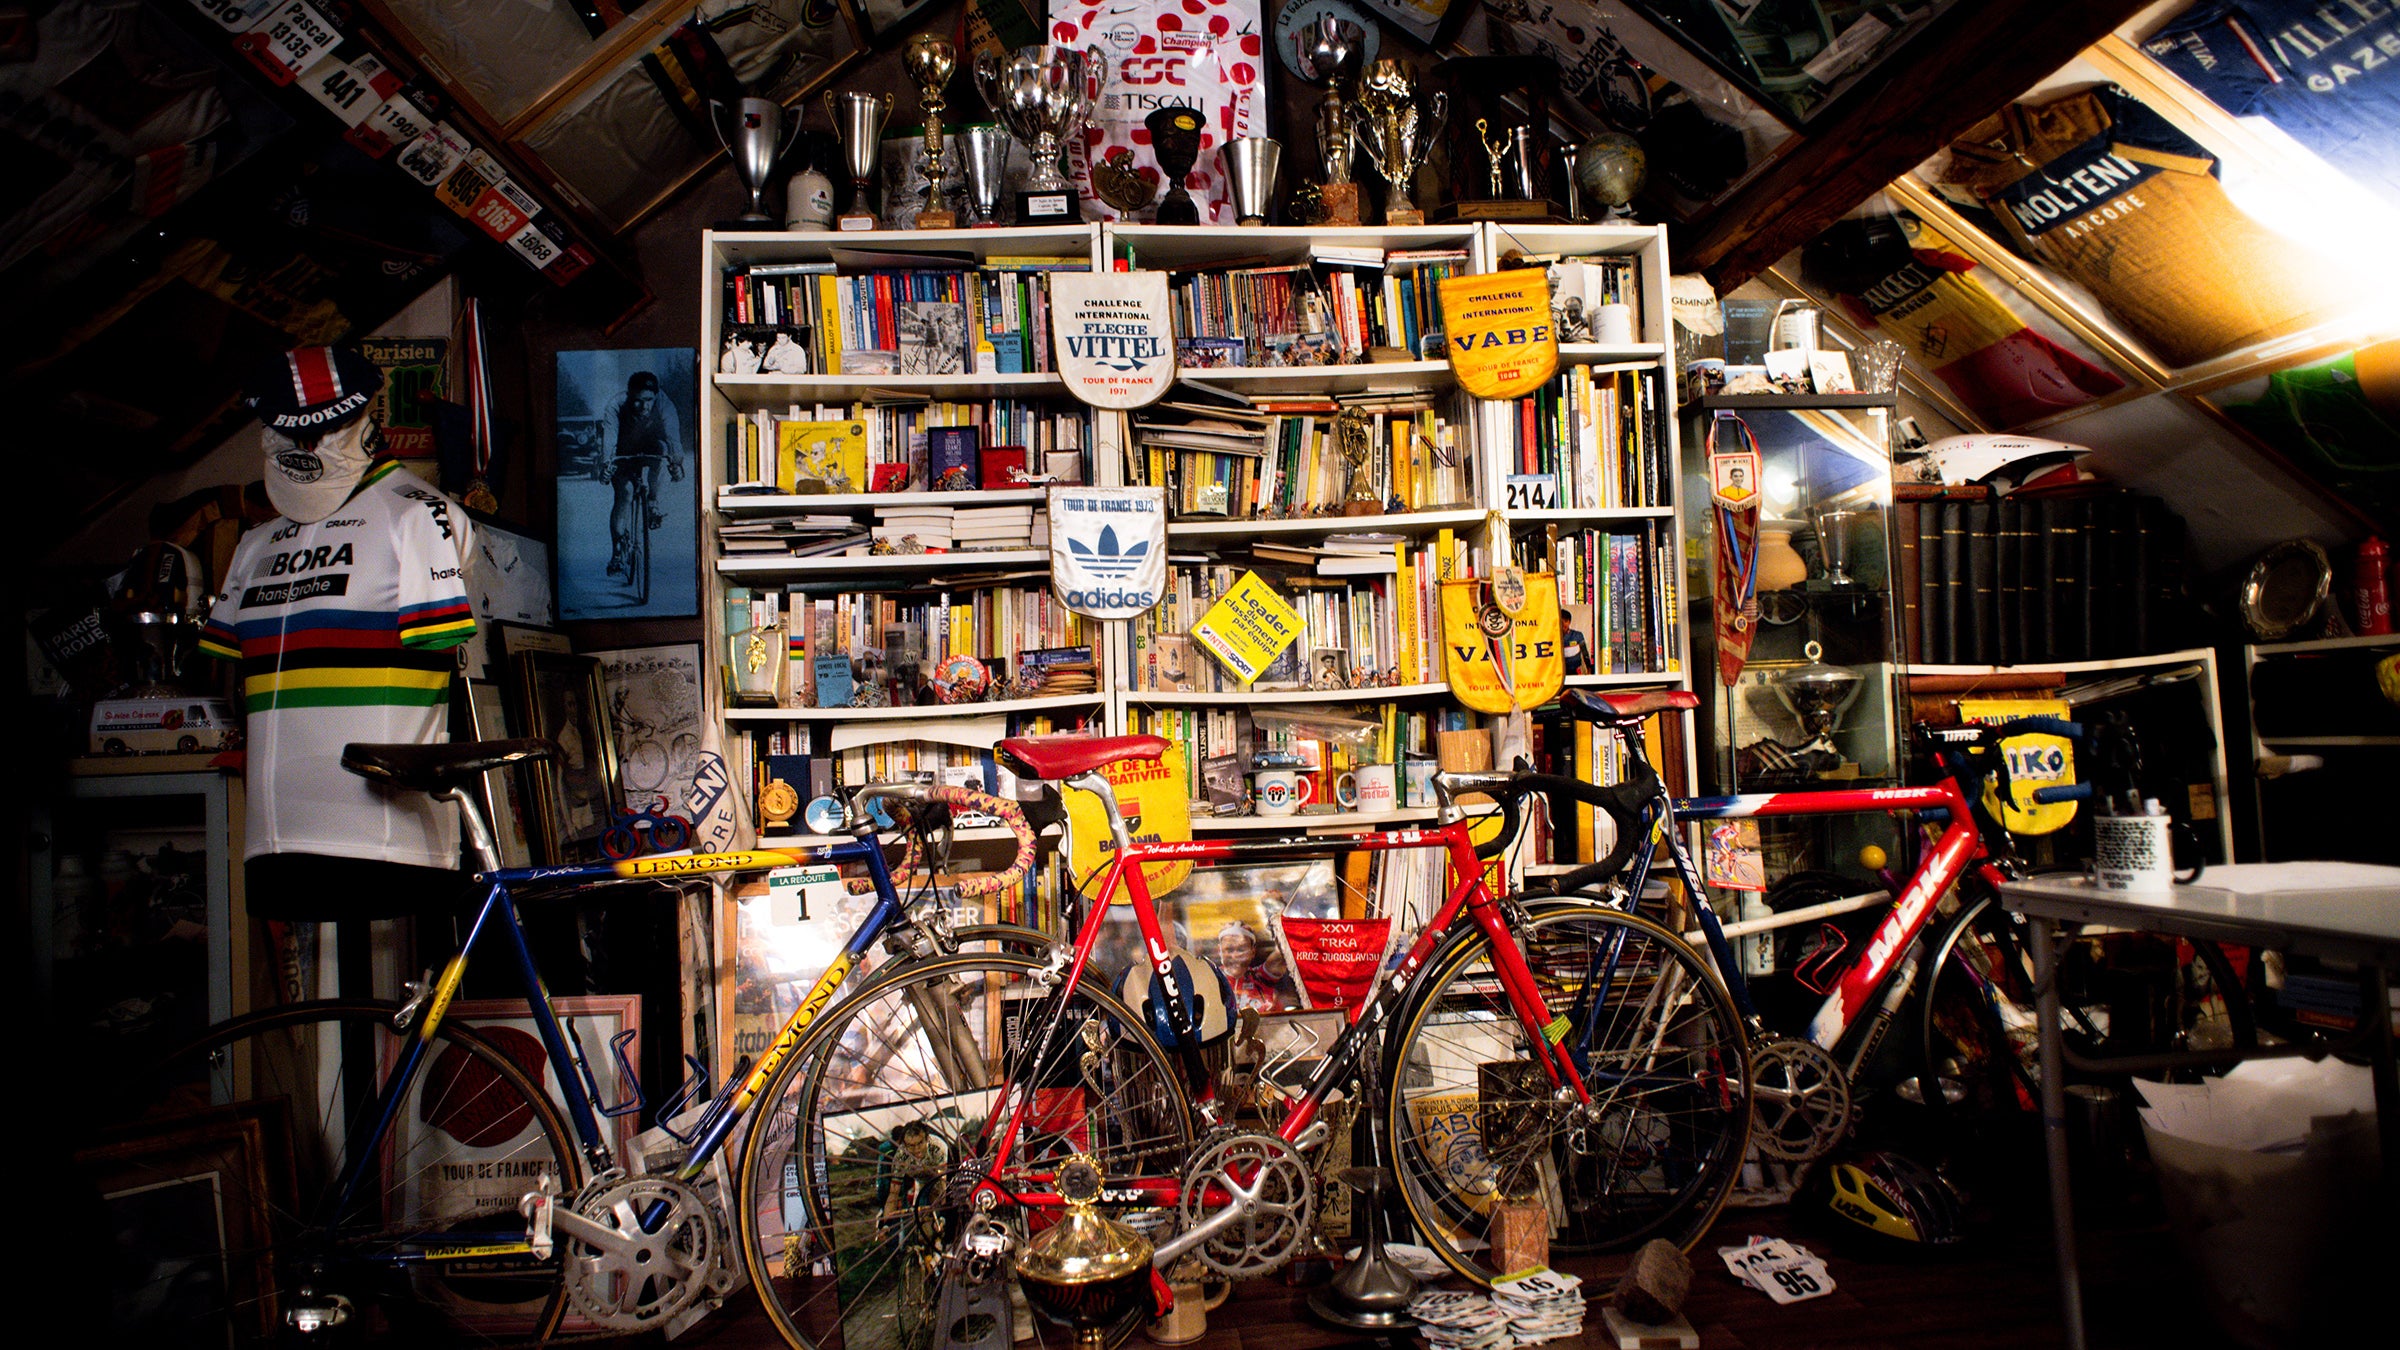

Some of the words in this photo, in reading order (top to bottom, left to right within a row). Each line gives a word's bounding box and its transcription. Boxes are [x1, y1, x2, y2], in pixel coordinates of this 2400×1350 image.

[285, 3, 334, 47] Pascal
[269, 22, 311, 59] 13135
[1163, 37, 1212, 48] Champion
[1121, 58, 1186, 86] CSC
[322, 69, 367, 110] 441
[476, 198, 518, 233] 3163
[2064, 193, 2147, 239] ARCORE
[859, 277, 868, 311] ANQUETIL
[1084, 300, 1142, 308] CHALLENGE
[1469, 291, 1524, 303] CHALLENGE
[827, 307, 836, 327] JAUNE
[1075, 312, 1151, 321] INTERNATIONAL
[1463, 306, 1534, 319] INTERNATIONAL
[1083, 323, 1148, 335] FLECHE
[1454, 326, 1549, 351] VABE
[362, 343, 436, 360] Parisien
[827, 328, 836, 355] MAILLOT
[1066, 336, 1166, 359] VITTEL
[1478, 363, 1498, 372] TOUR
[1513, 357, 1539, 367] FRANCE
[273, 392, 368, 428] BROOKLYN
[404, 489, 453, 541] BORA
[1063, 499, 1085, 511] TOUR
[1088, 499, 1098, 512] DE
[1101, 500, 1132, 512] FRANCE
[1135, 500, 1154, 512] 1973
[275, 524, 299, 542] UCI
[325, 518, 359, 528] CRAFT
[270, 543, 353, 577] BORA
[430, 567, 464, 582] hansg
[255, 579, 332, 602] hansgrohe
[1066, 587, 1153, 609] adidas
[940, 592, 950, 619] TOUR
[1240, 588, 1290, 637] Leader
[1246, 609, 1258, 621] du
[1225, 598, 1279, 649] classement
[1409, 612, 1415, 621] DU
[1137, 635, 1146, 649] 83
[1232, 617, 1248, 631] par
[1248, 630, 1276, 657] équipe
[1409, 622, 1417, 668] MONUMENTS
[1208, 634, 1252, 676] INTERSPORT
[1469, 684, 1490, 692] TOUR
[1122, 760, 1140, 771] DE
[1146, 758, 1163, 769] LA
[2006, 748, 2066, 775] IKO
[1110, 768, 1171, 786] BATIVITE
[1360, 789, 1371, 800] Giro
[1372, 788, 1390, 800] d'Italia
[1872, 788, 1928, 800] MBK
[632, 854, 752, 876] LEMOND
[779, 877, 789, 886] LA
[790, 874, 827, 884] REDOUTE
[1679, 845, 1711, 913] MBK
[796, 888, 811, 921] 1
[1865, 851, 1949, 977] MBK
[1321, 924, 1354, 934] XXVI
[1319, 938, 1358, 948] TRKA
[1296, 953, 1319, 961] KROZ
[1322, 952, 1380, 962] JUGOSLAVIJU
[743, 967, 847, 1102] LEMOND
[1418, 1105, 1453, 1114] DEPUIS
[1457, 1103, 1479, 1112] VING
[443, 1163, 474, 1180] TOUR
[477, 1162, 493, 1178] DE
[496, 1160, 544, 1177] FRANCE
[426, 1245, 471, 1257] MAVIC
[1516, 1277, 1554, 1294] 46
[1772, 1267, 1821, 1297] 95
